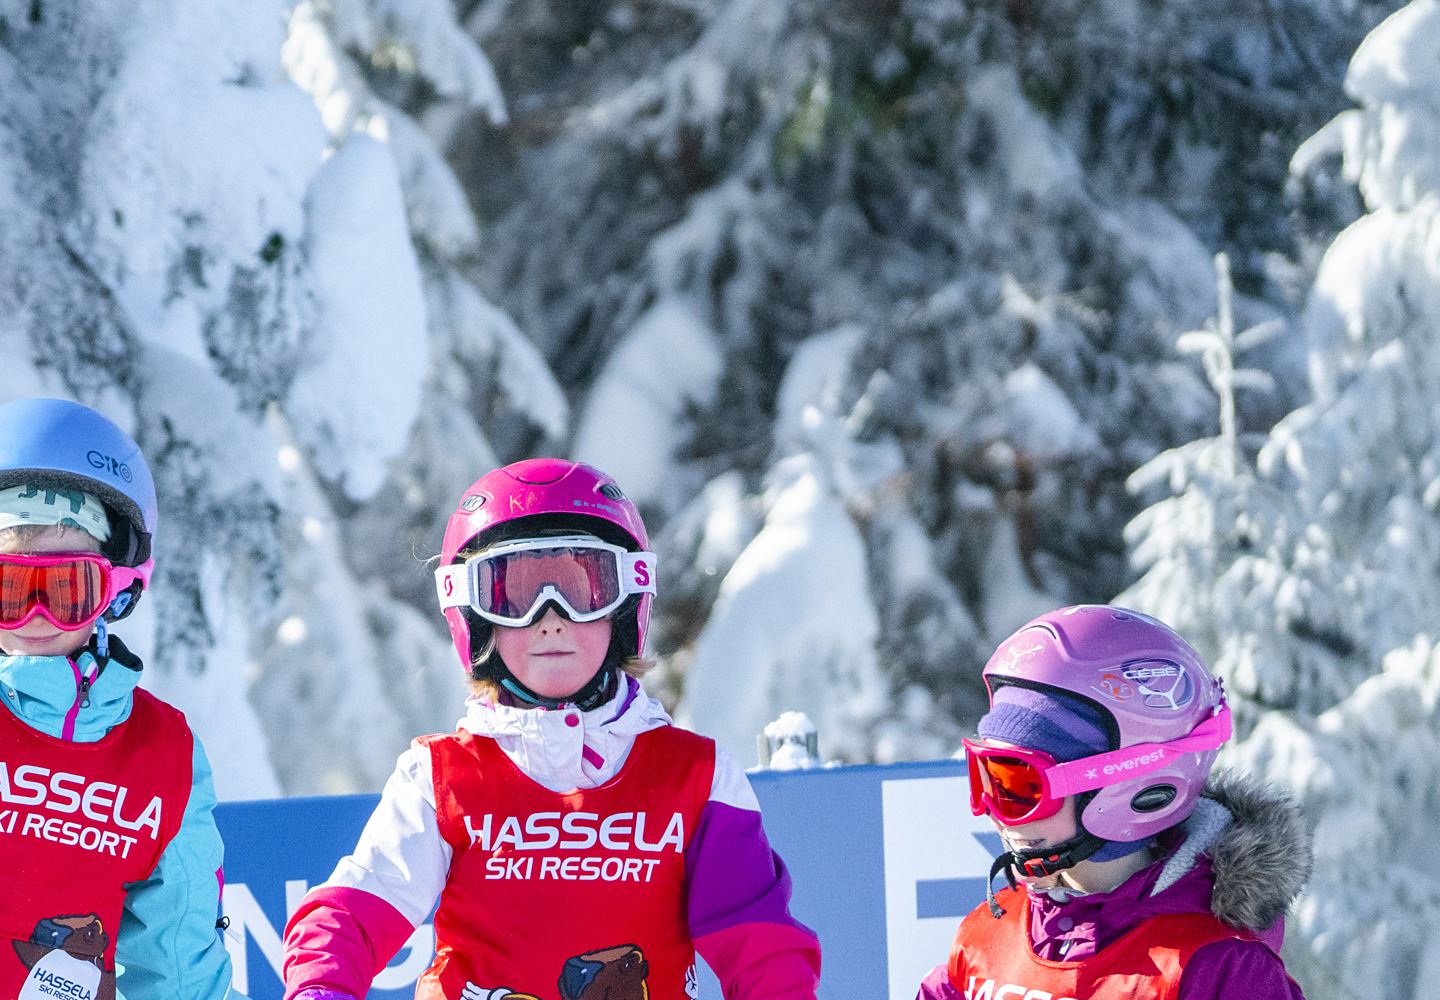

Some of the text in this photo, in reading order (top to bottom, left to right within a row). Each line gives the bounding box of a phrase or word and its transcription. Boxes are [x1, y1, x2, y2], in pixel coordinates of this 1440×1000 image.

[87, 450, 133, 484] GIRO
[1103, 748, 1165, 775] everest
[21, 813, 137, 859] RESORT
[463, 811, 684, 853] HASSELA
[485, 857, 661, 882] SKI RESORT
[38, 984, 53, 995] SKI
